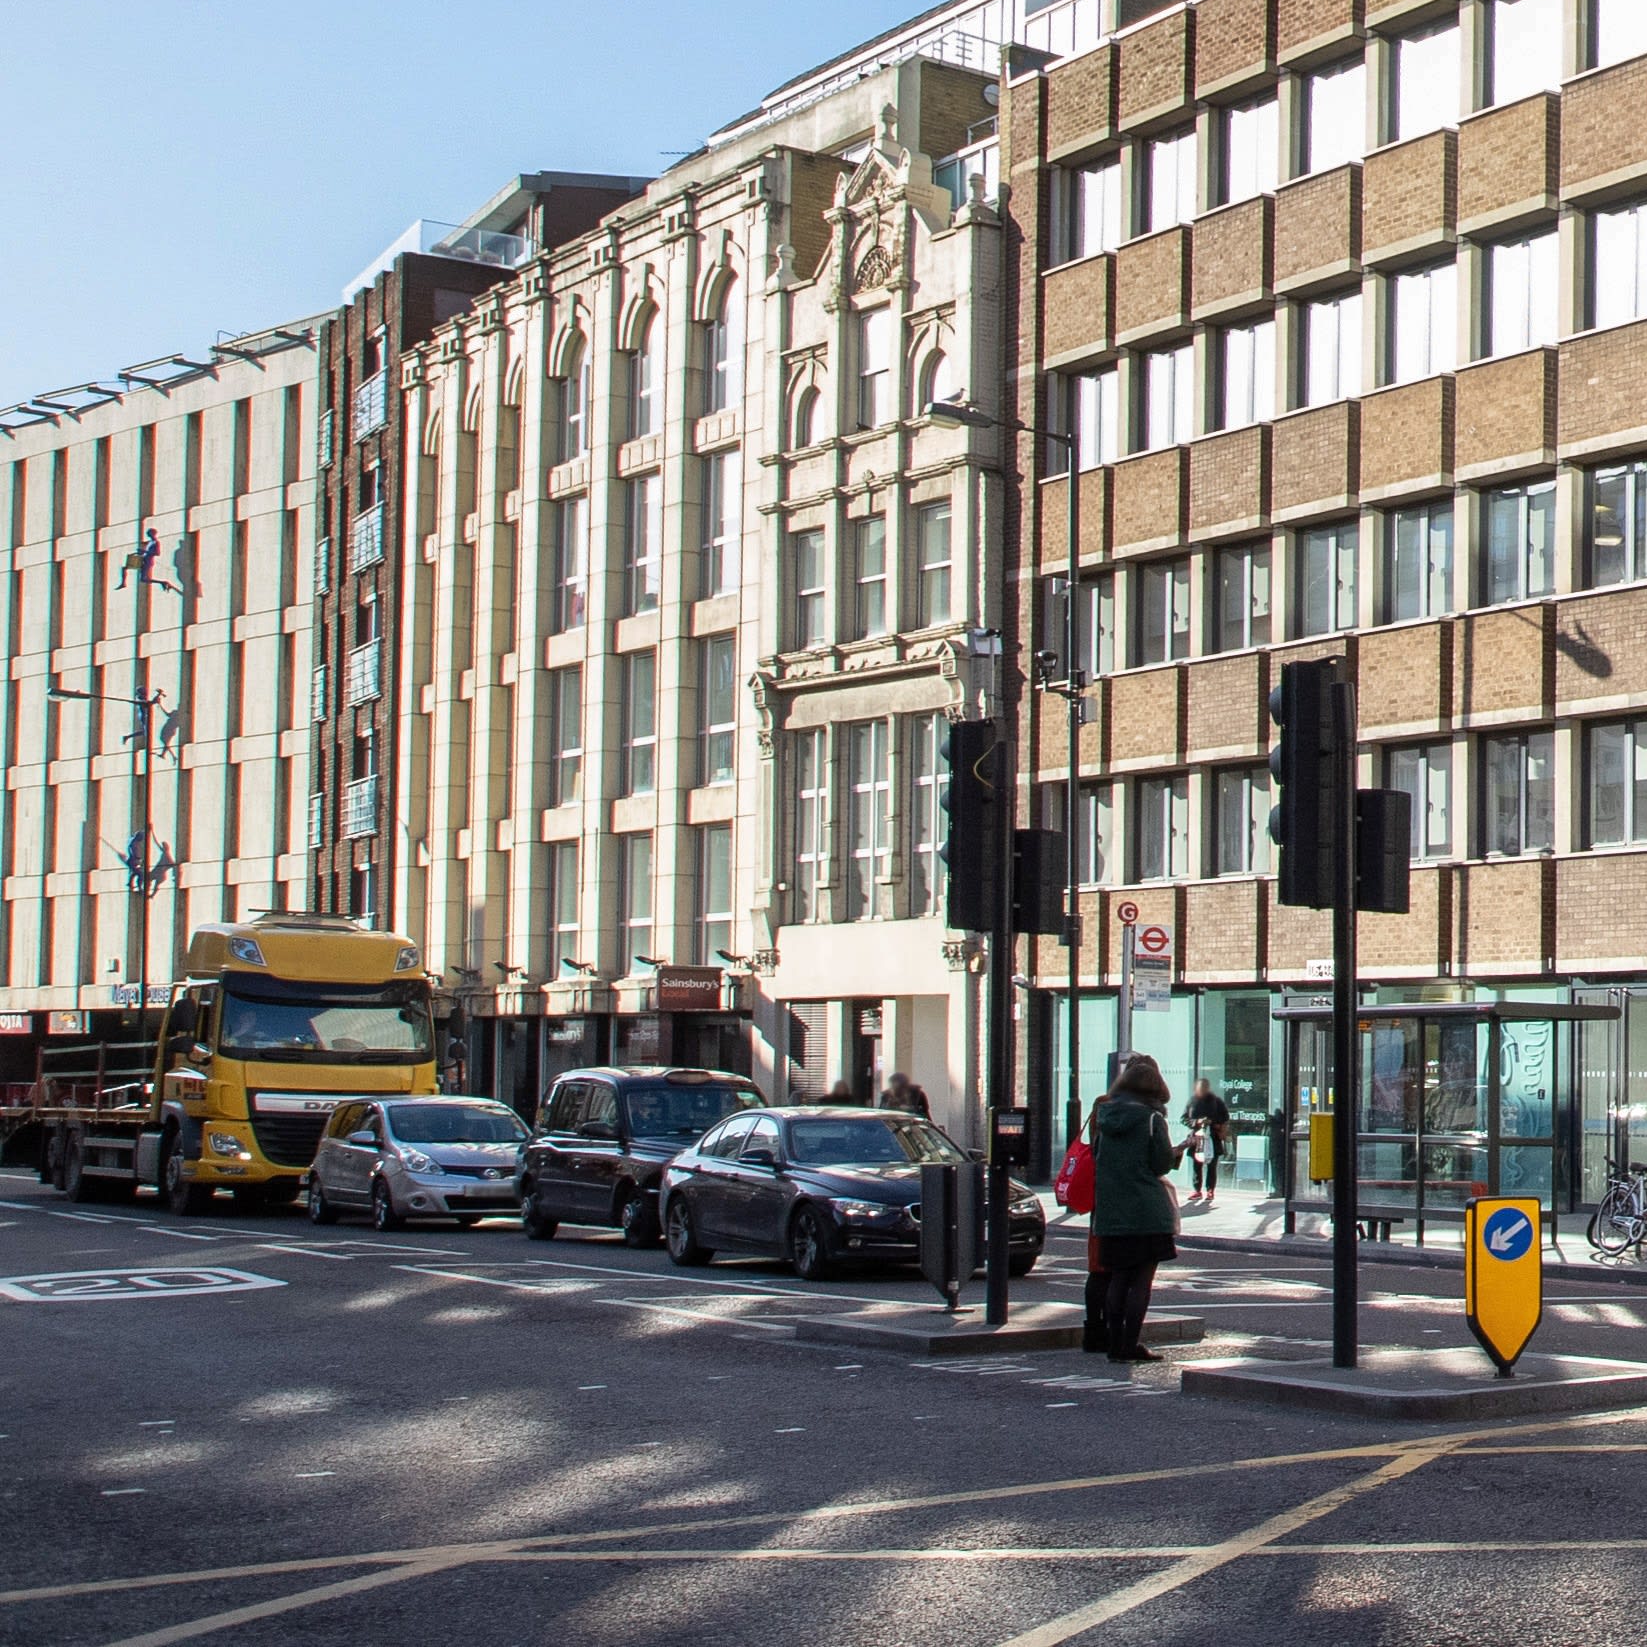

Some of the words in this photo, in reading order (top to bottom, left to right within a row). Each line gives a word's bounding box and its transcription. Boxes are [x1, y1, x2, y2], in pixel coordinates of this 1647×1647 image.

[1121, 905, 1136, 921] G
[662, 978, 719, 990] Sainsbury's
[1234, 1080, 1253, 1092] College
[304, 1101, 333, 1110] DA
